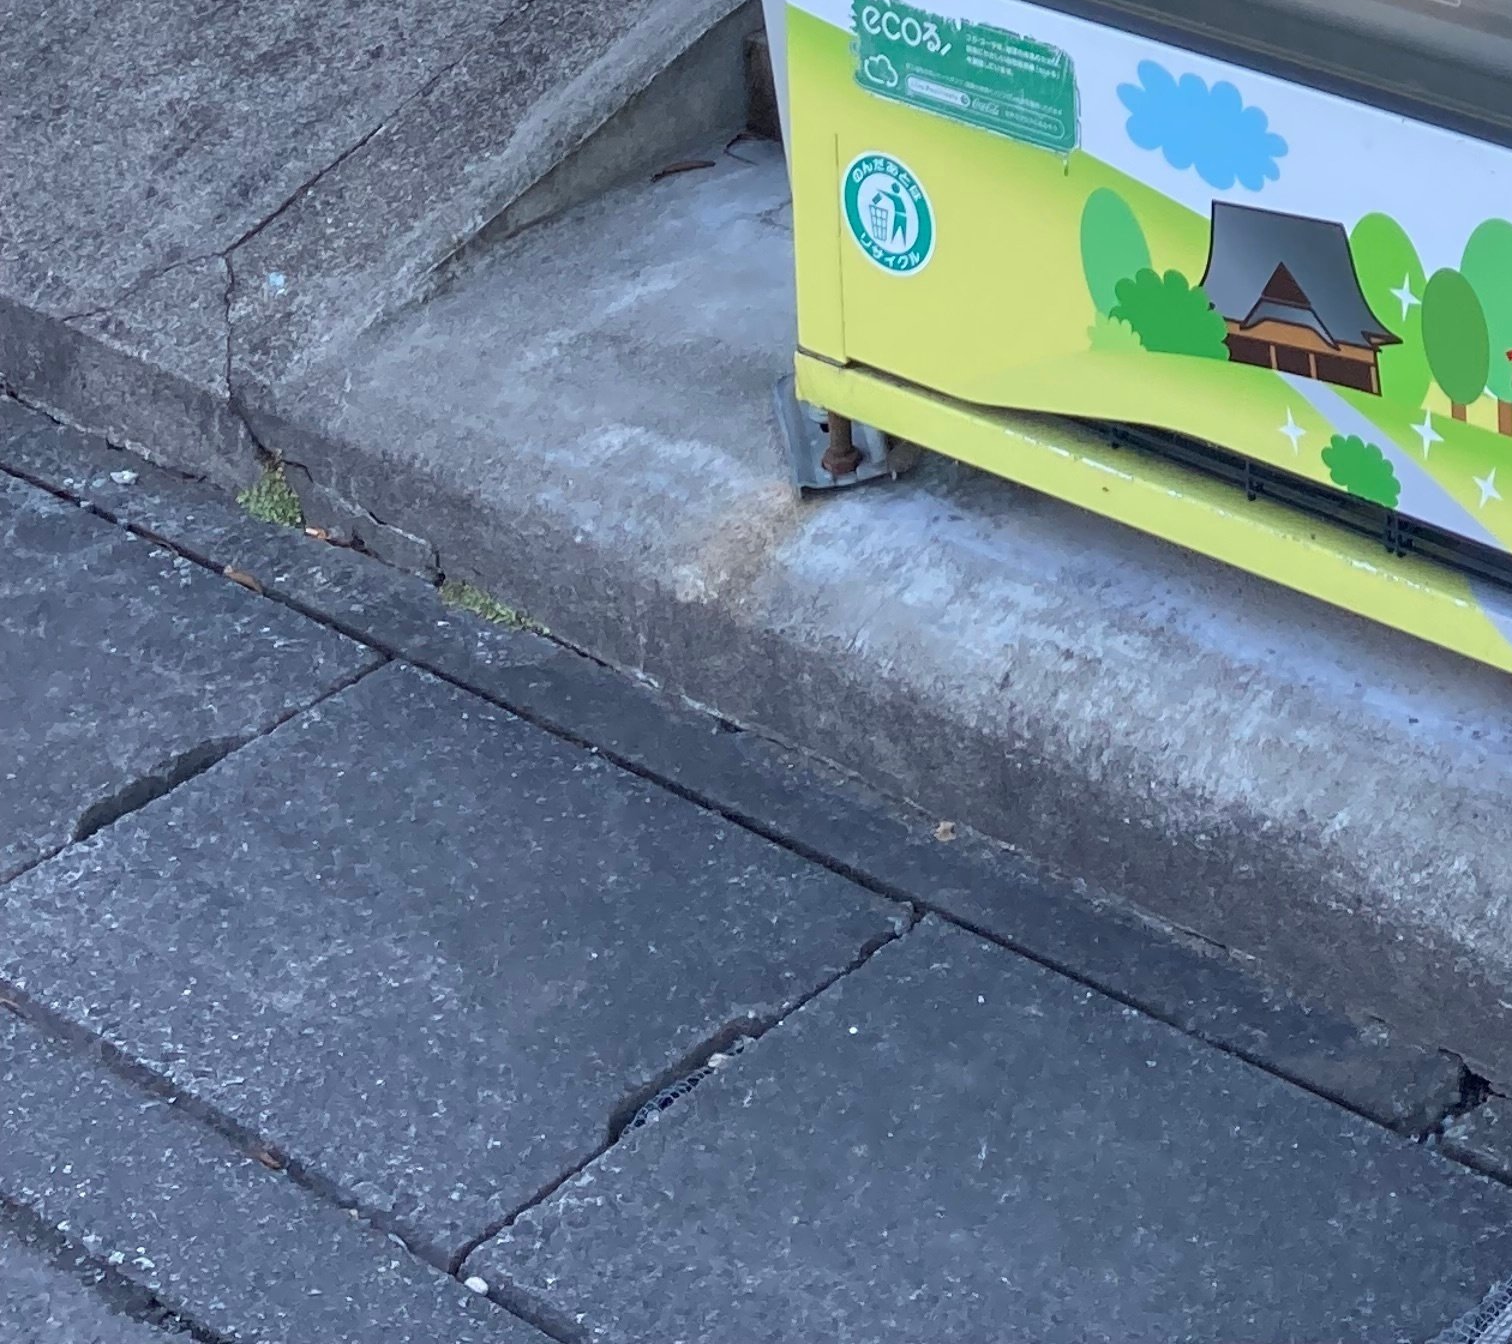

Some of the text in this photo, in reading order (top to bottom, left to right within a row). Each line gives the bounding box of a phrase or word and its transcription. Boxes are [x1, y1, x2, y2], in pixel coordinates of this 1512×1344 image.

[852, 160, 922, 203] のんだあとは
[860, 231, 920, 269] リサイクル
